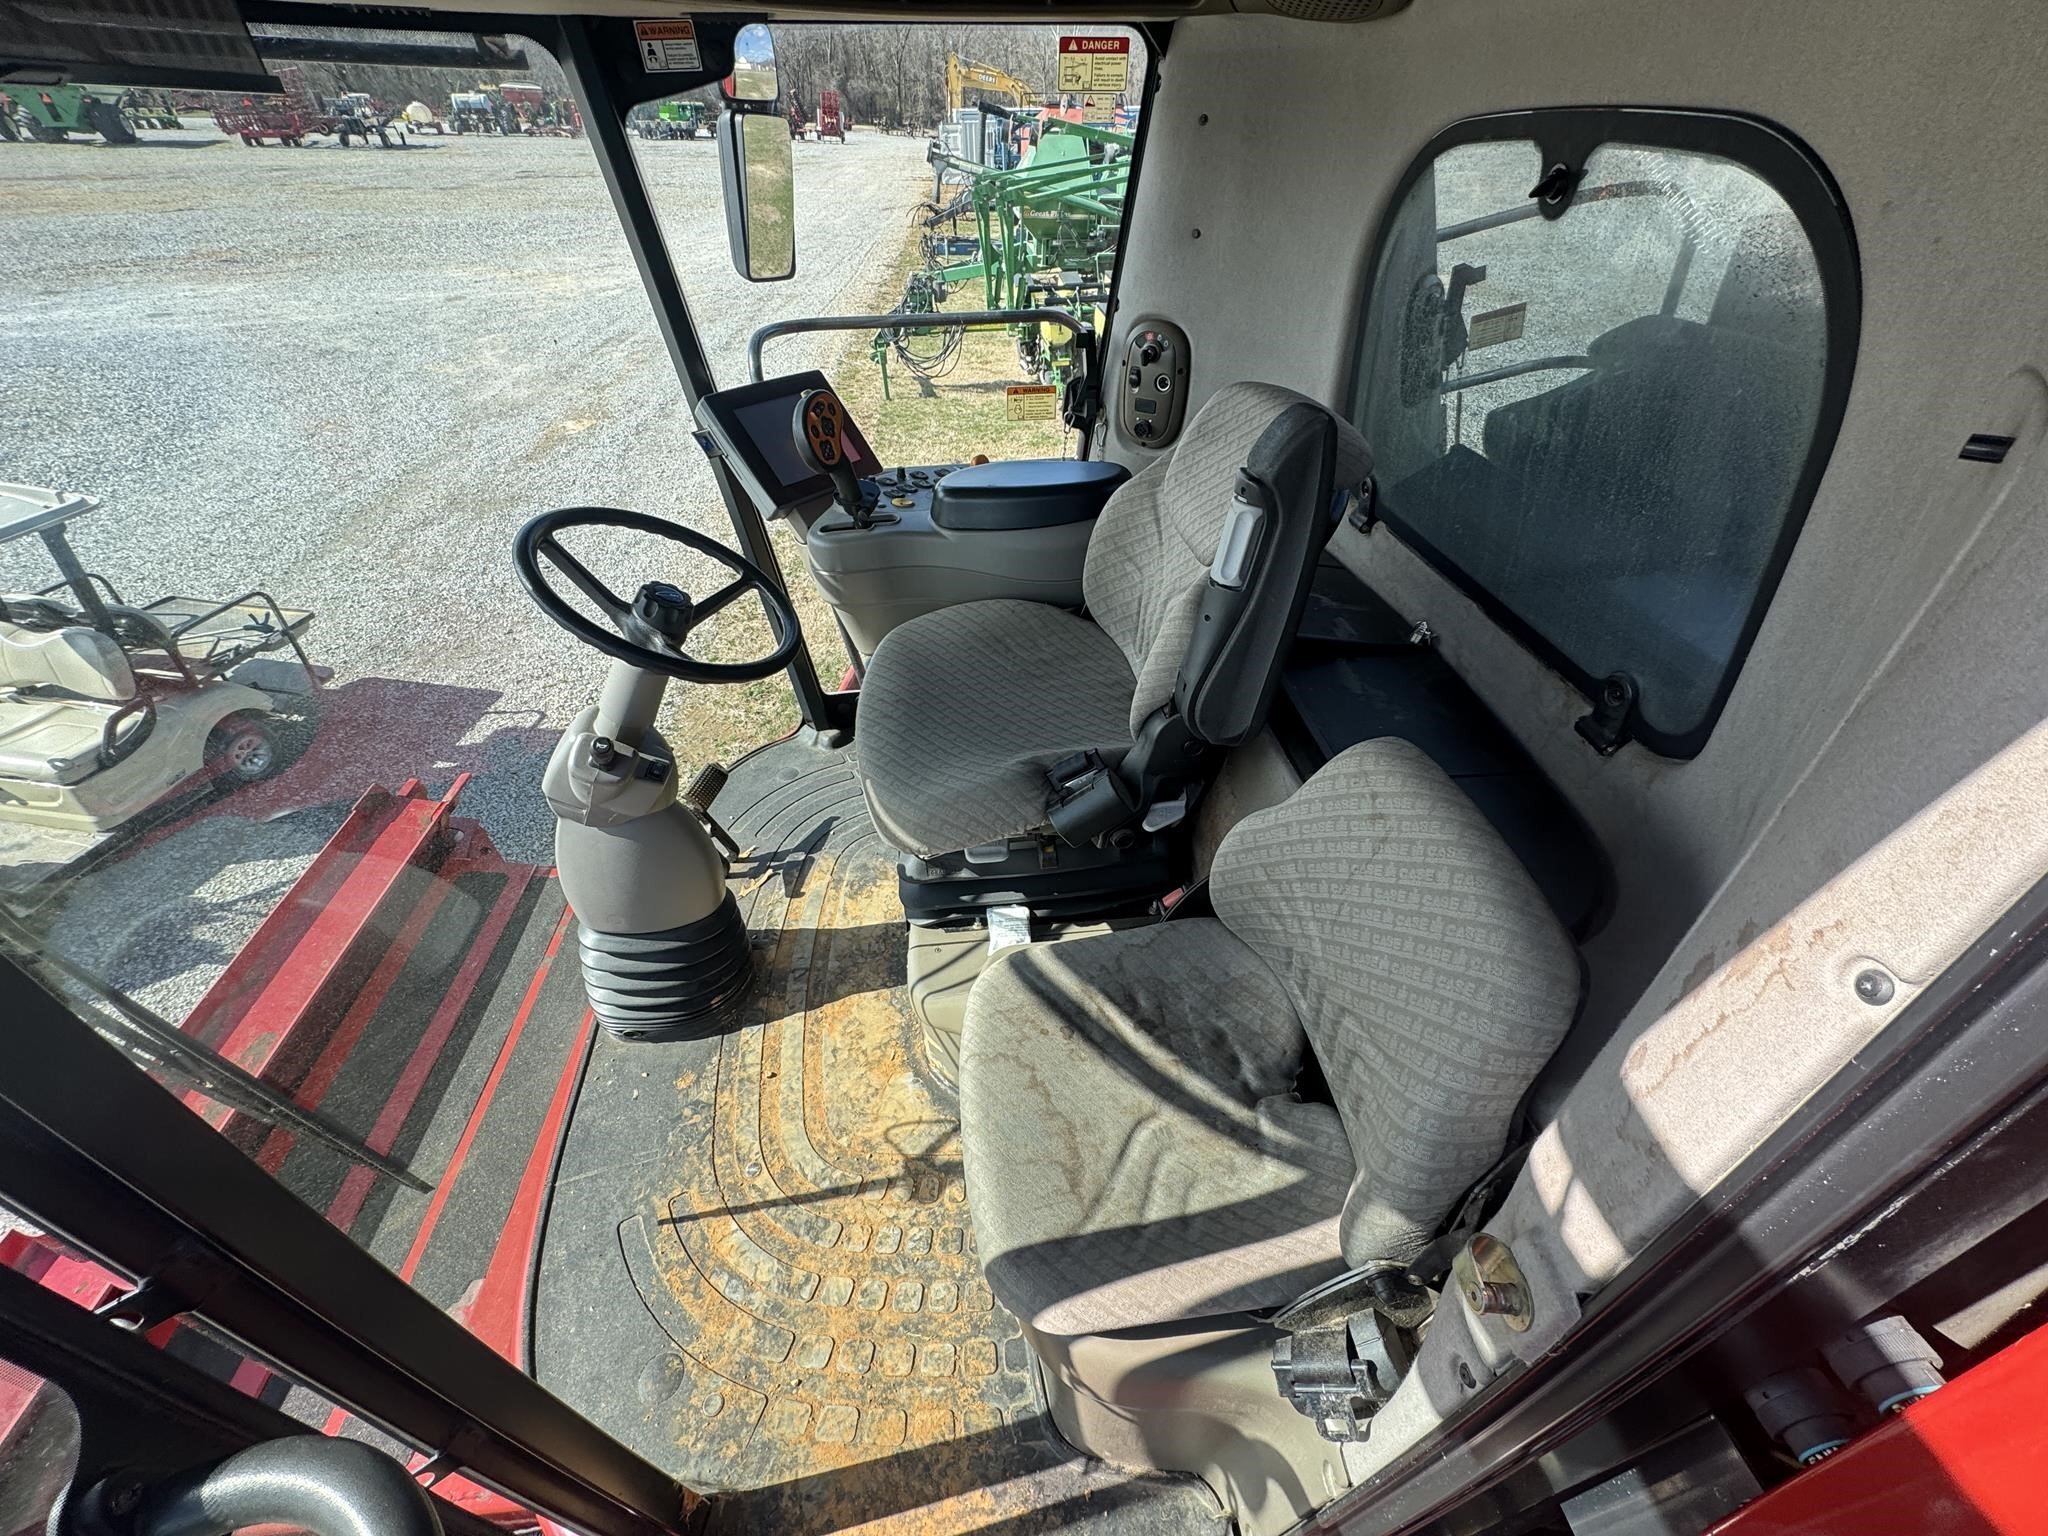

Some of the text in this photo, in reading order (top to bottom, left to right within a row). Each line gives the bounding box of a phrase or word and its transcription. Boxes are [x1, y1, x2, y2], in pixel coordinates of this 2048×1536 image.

[649, 24, 690, 35] WARNING
[1081, 40, 1120, 50] DANGER
[978, 73, 998, 84] DEERE
[1029, 209, 1050, 218] Great
